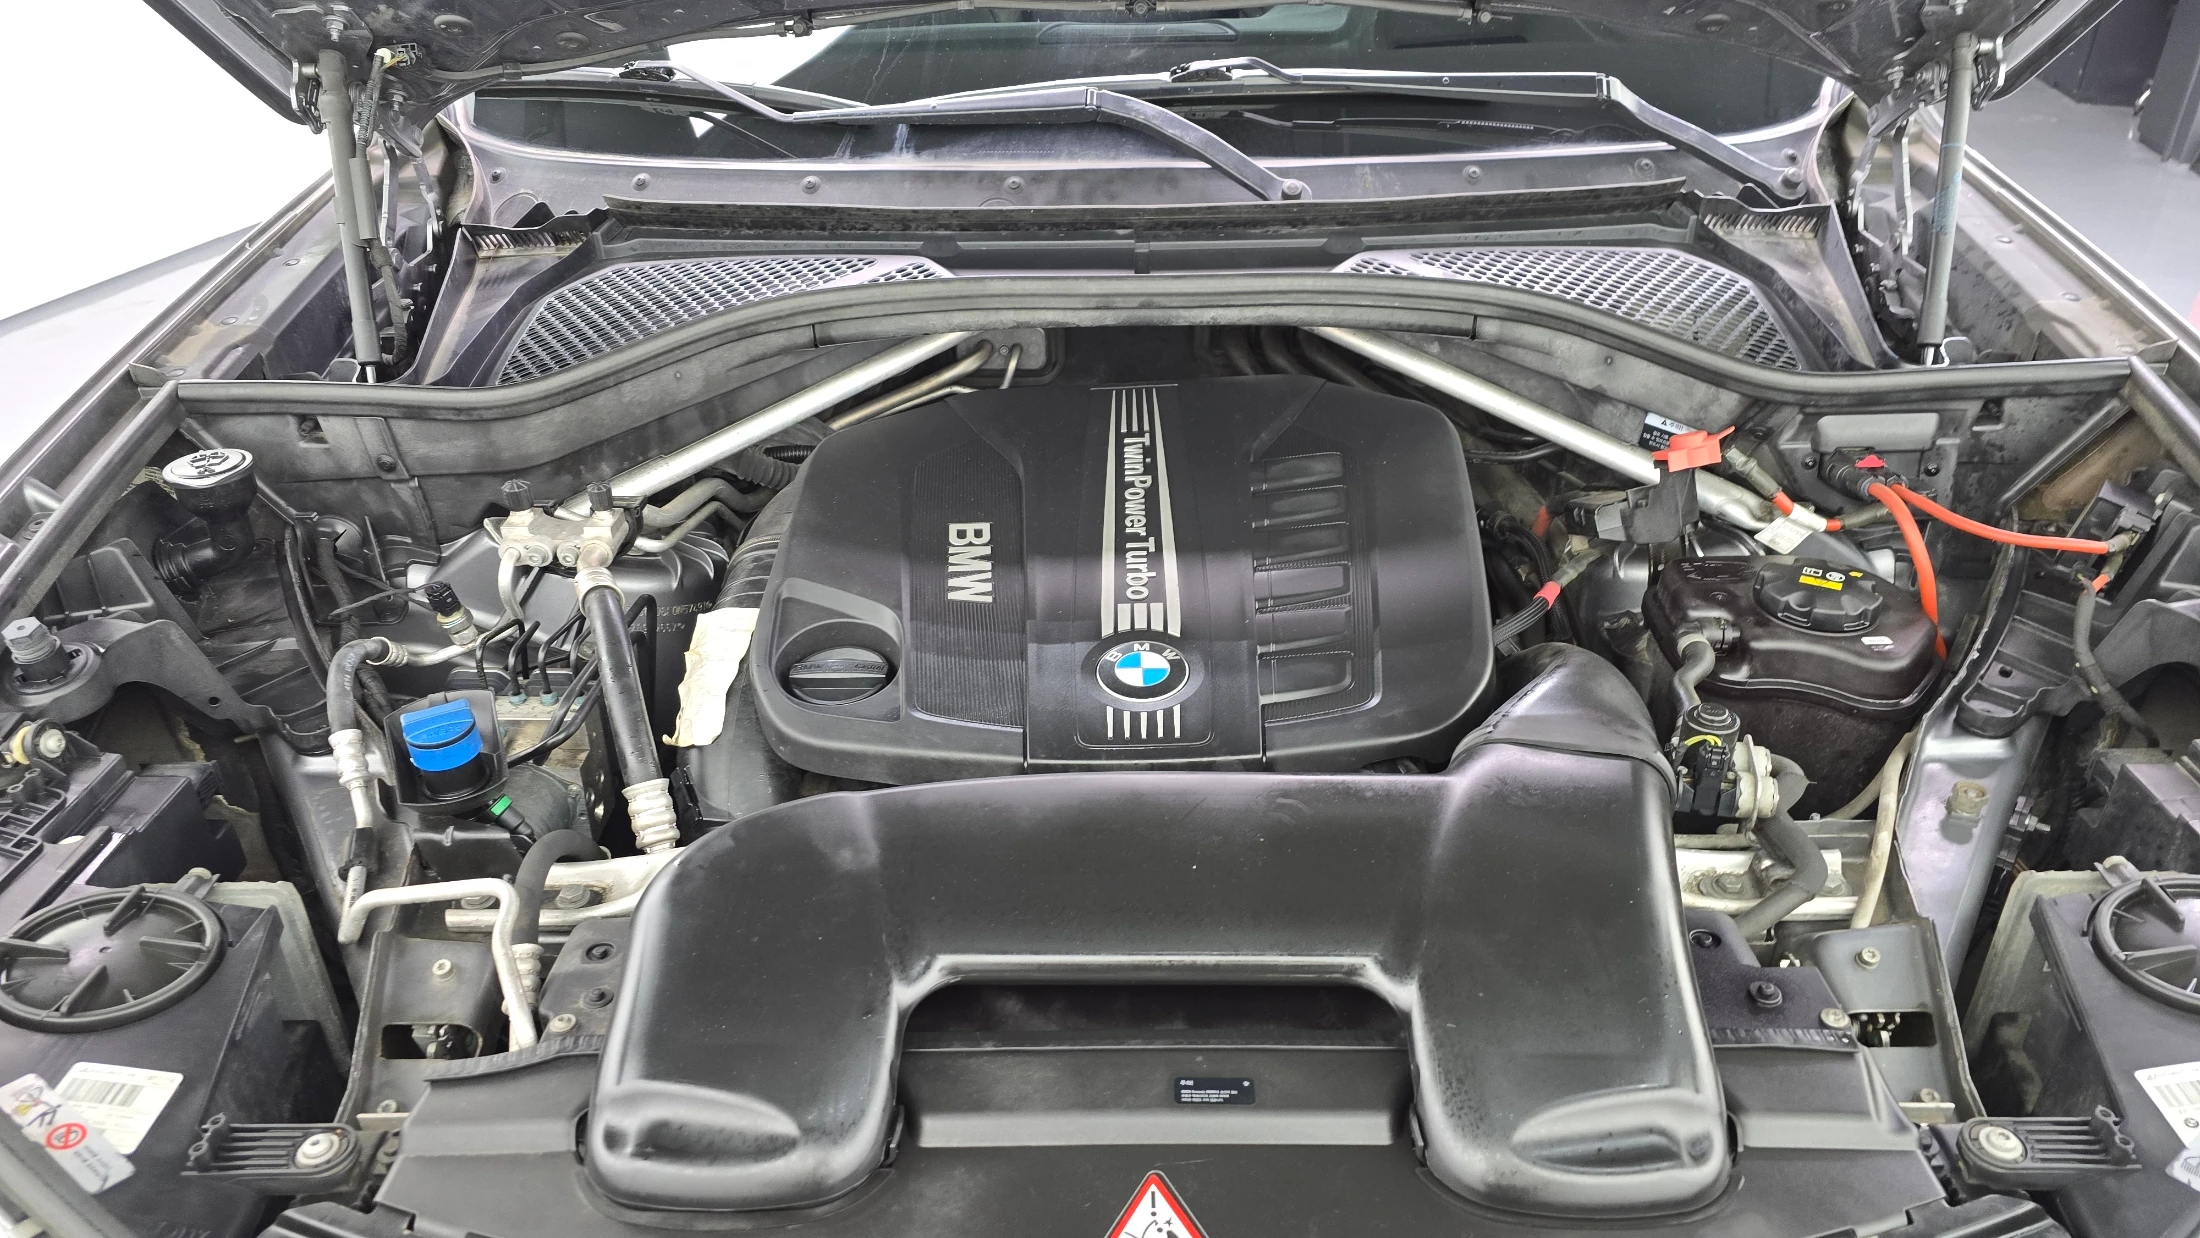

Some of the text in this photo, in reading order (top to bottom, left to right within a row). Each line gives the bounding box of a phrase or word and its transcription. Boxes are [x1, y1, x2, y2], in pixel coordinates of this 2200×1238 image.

[1123, 433, 1157, 600] TwinPower Turbo
[948, 522, 993, 602] BMW
[1105, 643, 1178, 661] BMW
